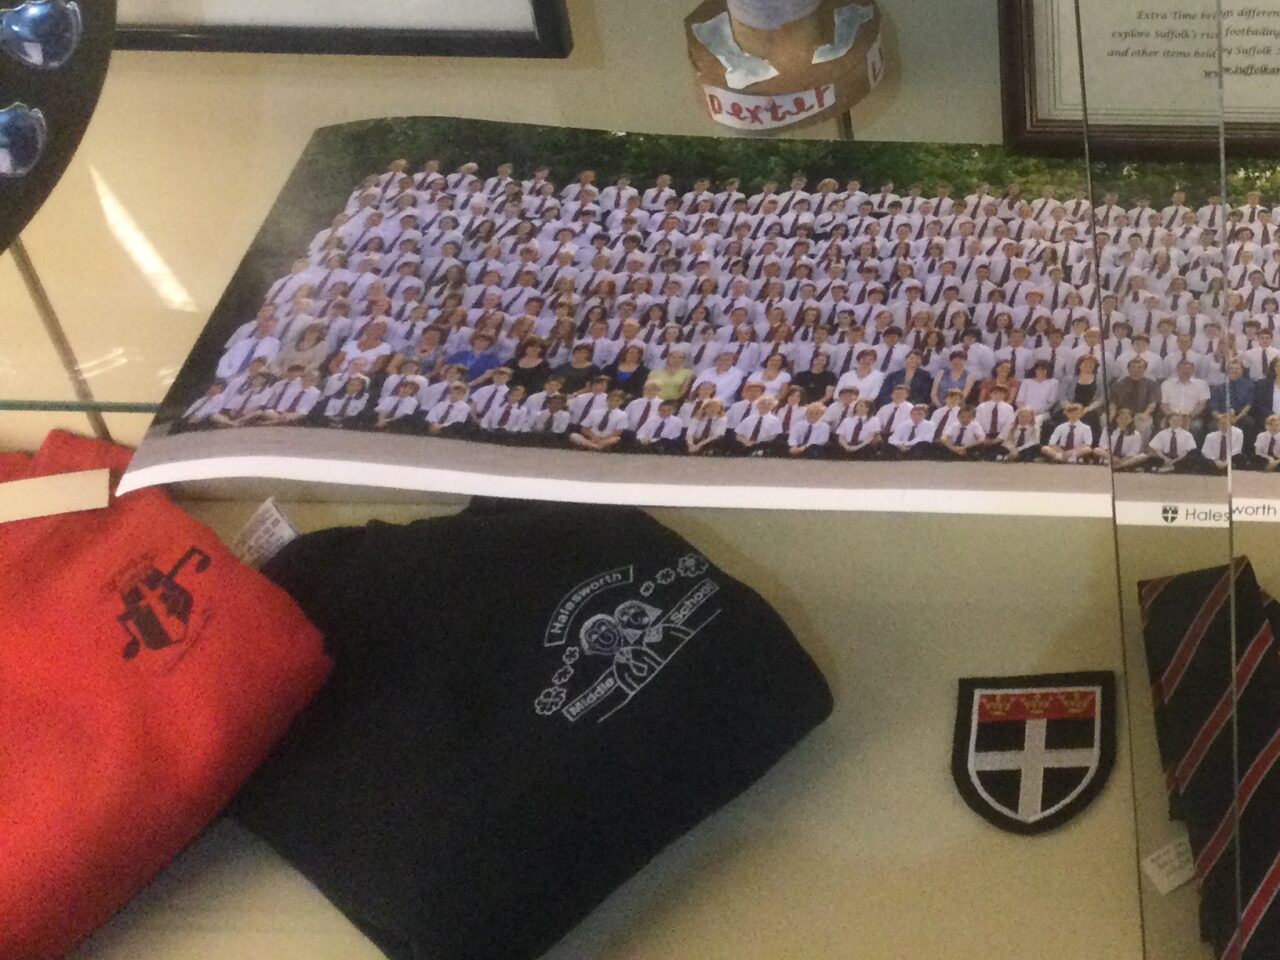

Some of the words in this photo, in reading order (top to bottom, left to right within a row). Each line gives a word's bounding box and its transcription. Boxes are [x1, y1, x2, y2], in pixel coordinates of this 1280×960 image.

[1136, 11, 1167, 20] Extra
[1171, 11, 1197, 21] Time
[1111, 28, 1150, 41] explore
[1107, 48, 1130, 58] and
[1236, 45, 1271, 56] Suffolk
[709, 86, 830, 124] Dexter
[1185, 503, 1277, 523] Halesworth
[550, 573, 622, 634] Halesworth
[670, 581, 715, 625] School
[567, 676, 616, 716] Middle
